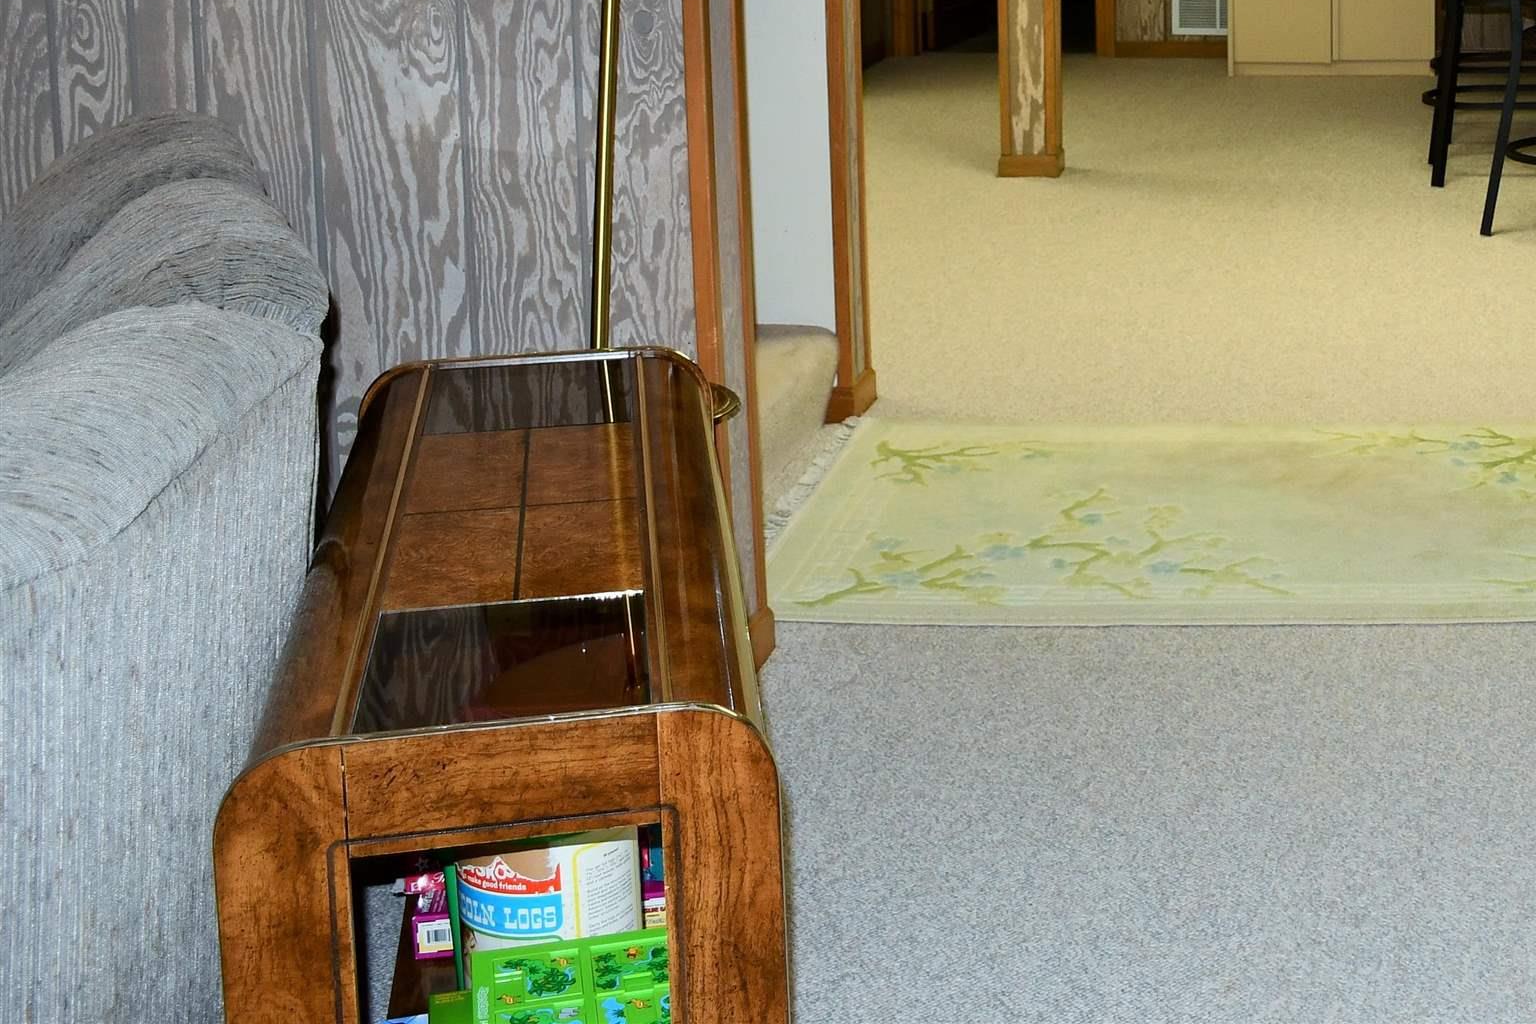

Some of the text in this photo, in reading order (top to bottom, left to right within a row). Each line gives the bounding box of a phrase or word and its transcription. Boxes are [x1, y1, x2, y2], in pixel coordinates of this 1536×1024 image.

[482, 880, 498, 890] good
[499, 881, 527, 891] friends
[503, 906, 557, 930] LOGS
